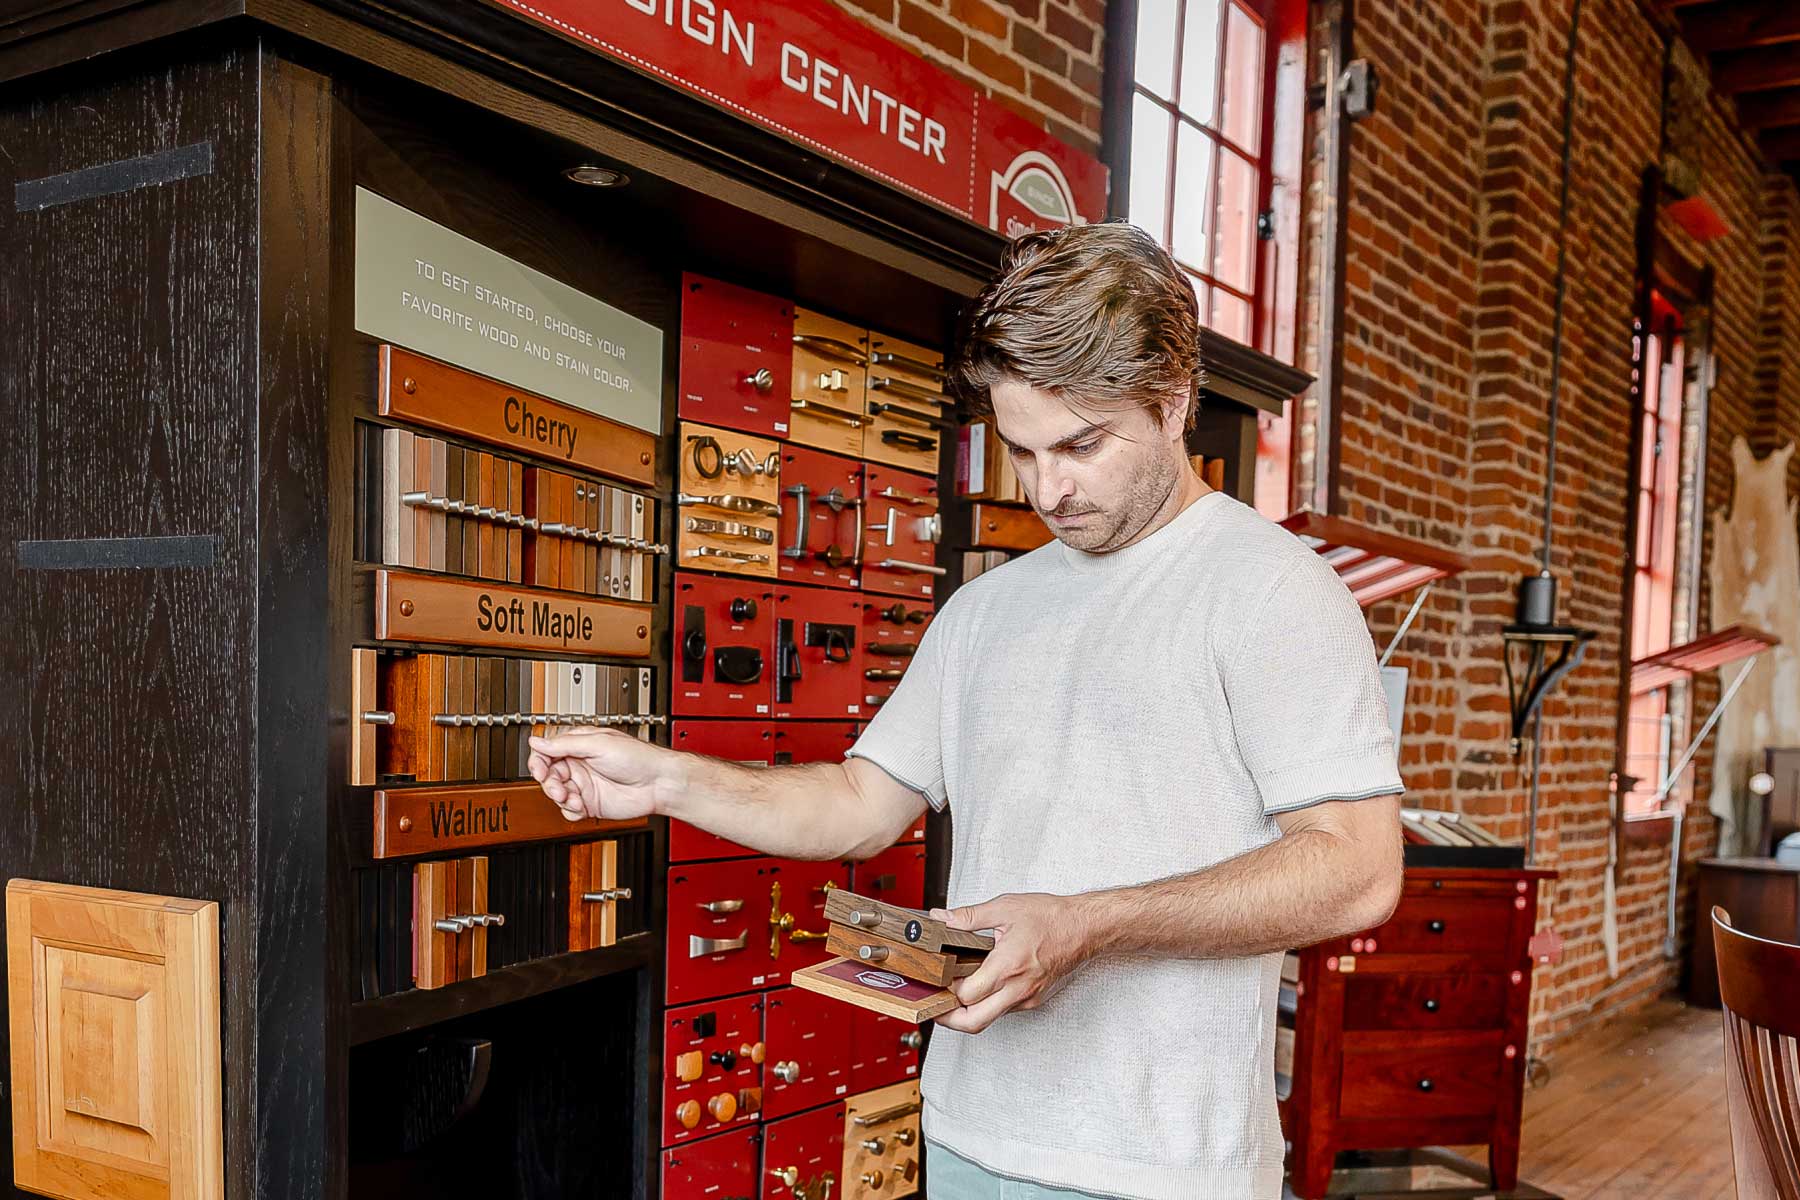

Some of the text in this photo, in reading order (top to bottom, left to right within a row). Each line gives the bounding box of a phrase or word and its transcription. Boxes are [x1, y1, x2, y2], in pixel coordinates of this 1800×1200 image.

[780, 41, 947, 166] CENTER
[401, 291, 633, 392] FAVORITE WOOD AND STAIN COLOR.
[415, 259, 626, 360] TO GET STARTED, CHOOSE YOUR
[504, 397, 577, 459] Cherry
[478, 595, 593, 647] Soft Maple
[430, 800, 510, 839] Walnut
